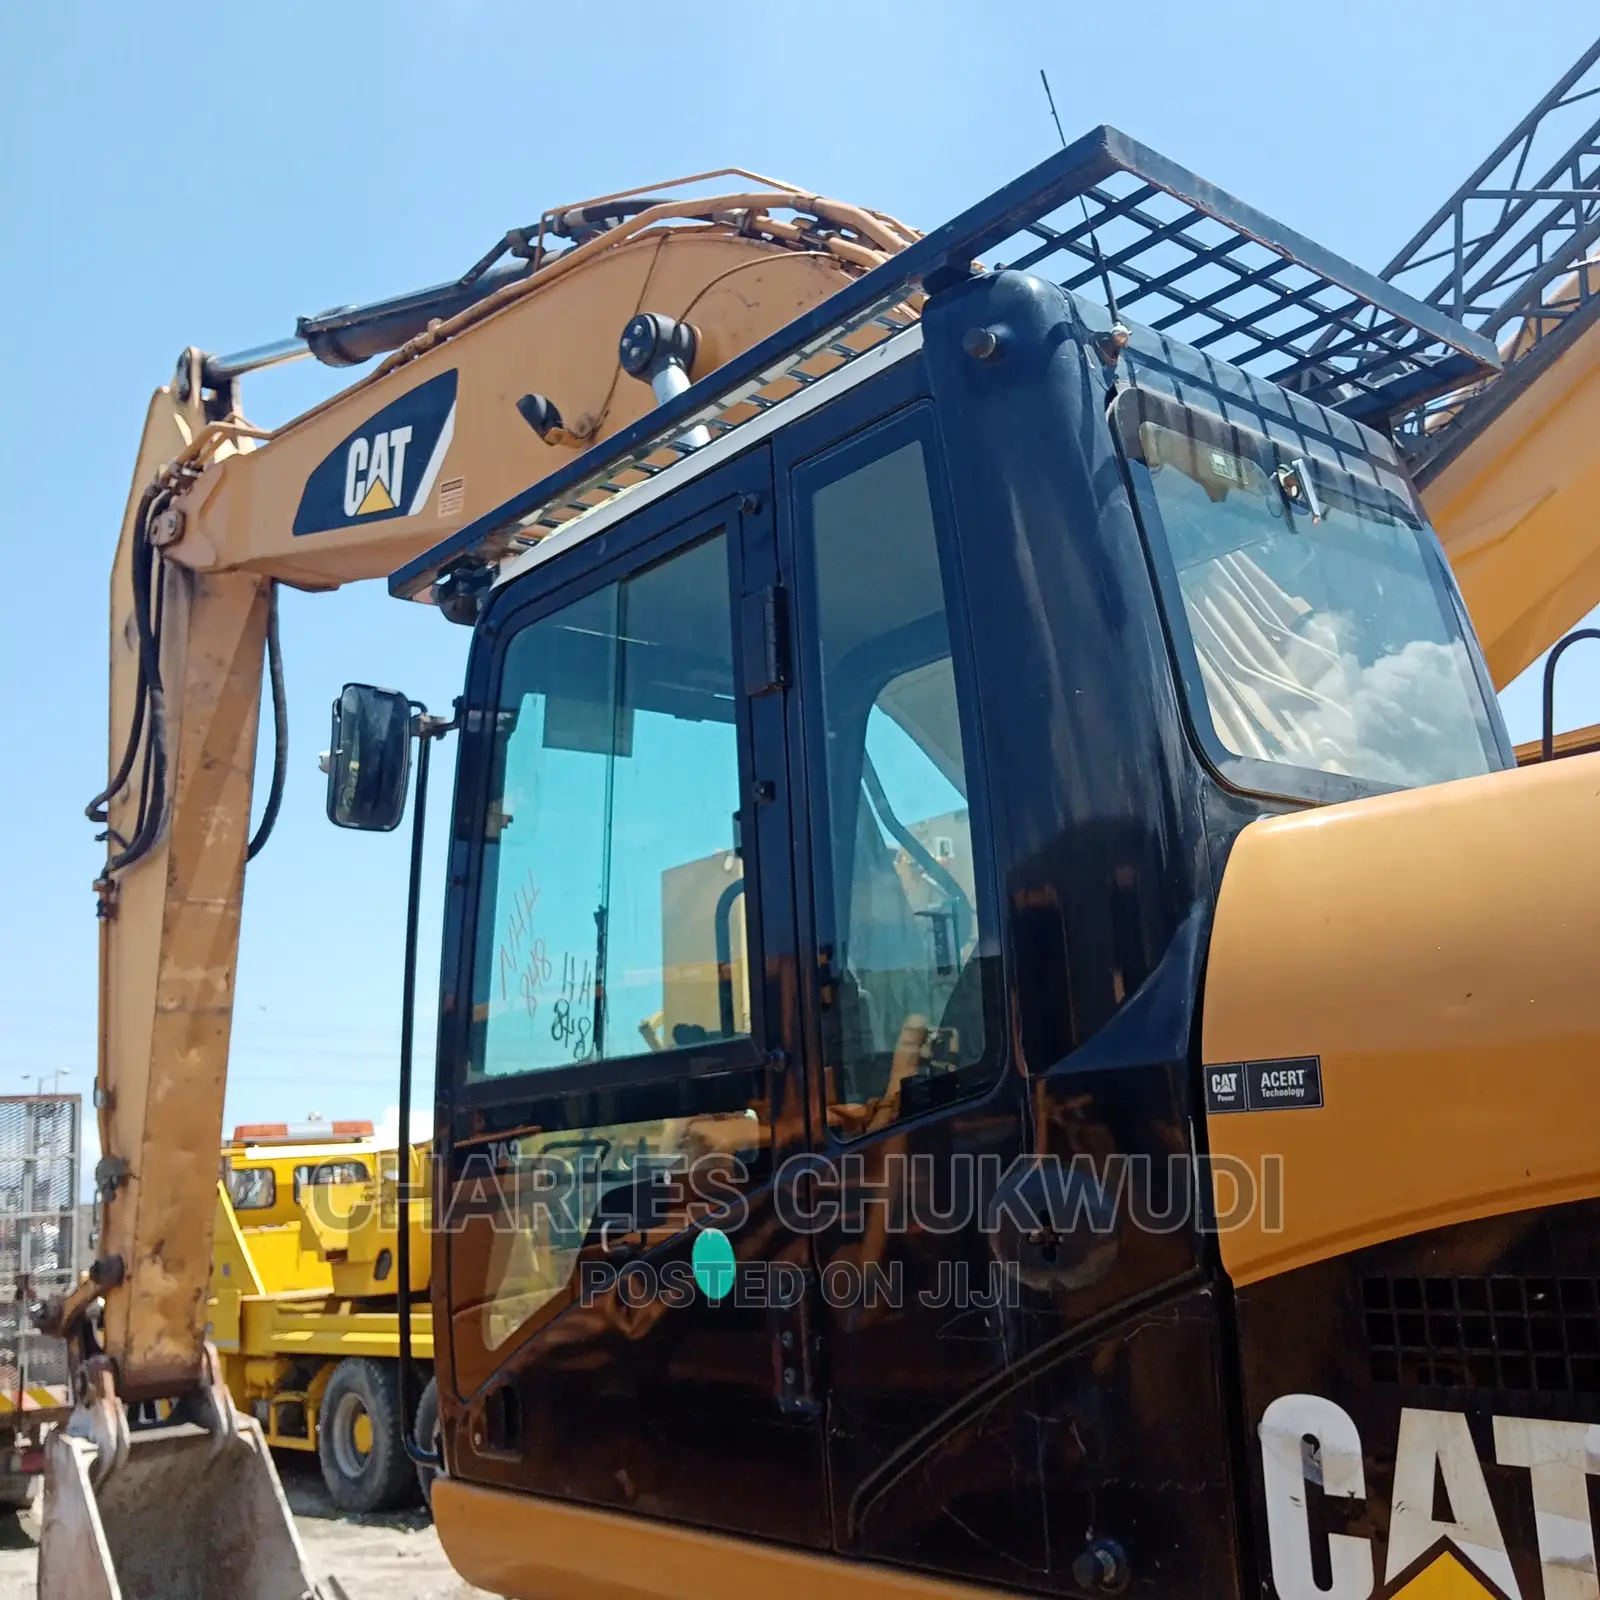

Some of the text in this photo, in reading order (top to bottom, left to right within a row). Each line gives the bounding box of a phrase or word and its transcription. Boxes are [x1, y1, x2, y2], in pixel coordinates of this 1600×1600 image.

[344, 426, 413, 517] CAT
[1211, 1073, 1238, 1094] CAT
[1261, 1069, 1305, 1088] ACERT
[1261, 1087, 1305, 1098] Technology
[1258, 1393, 1600, 1600] CAT
